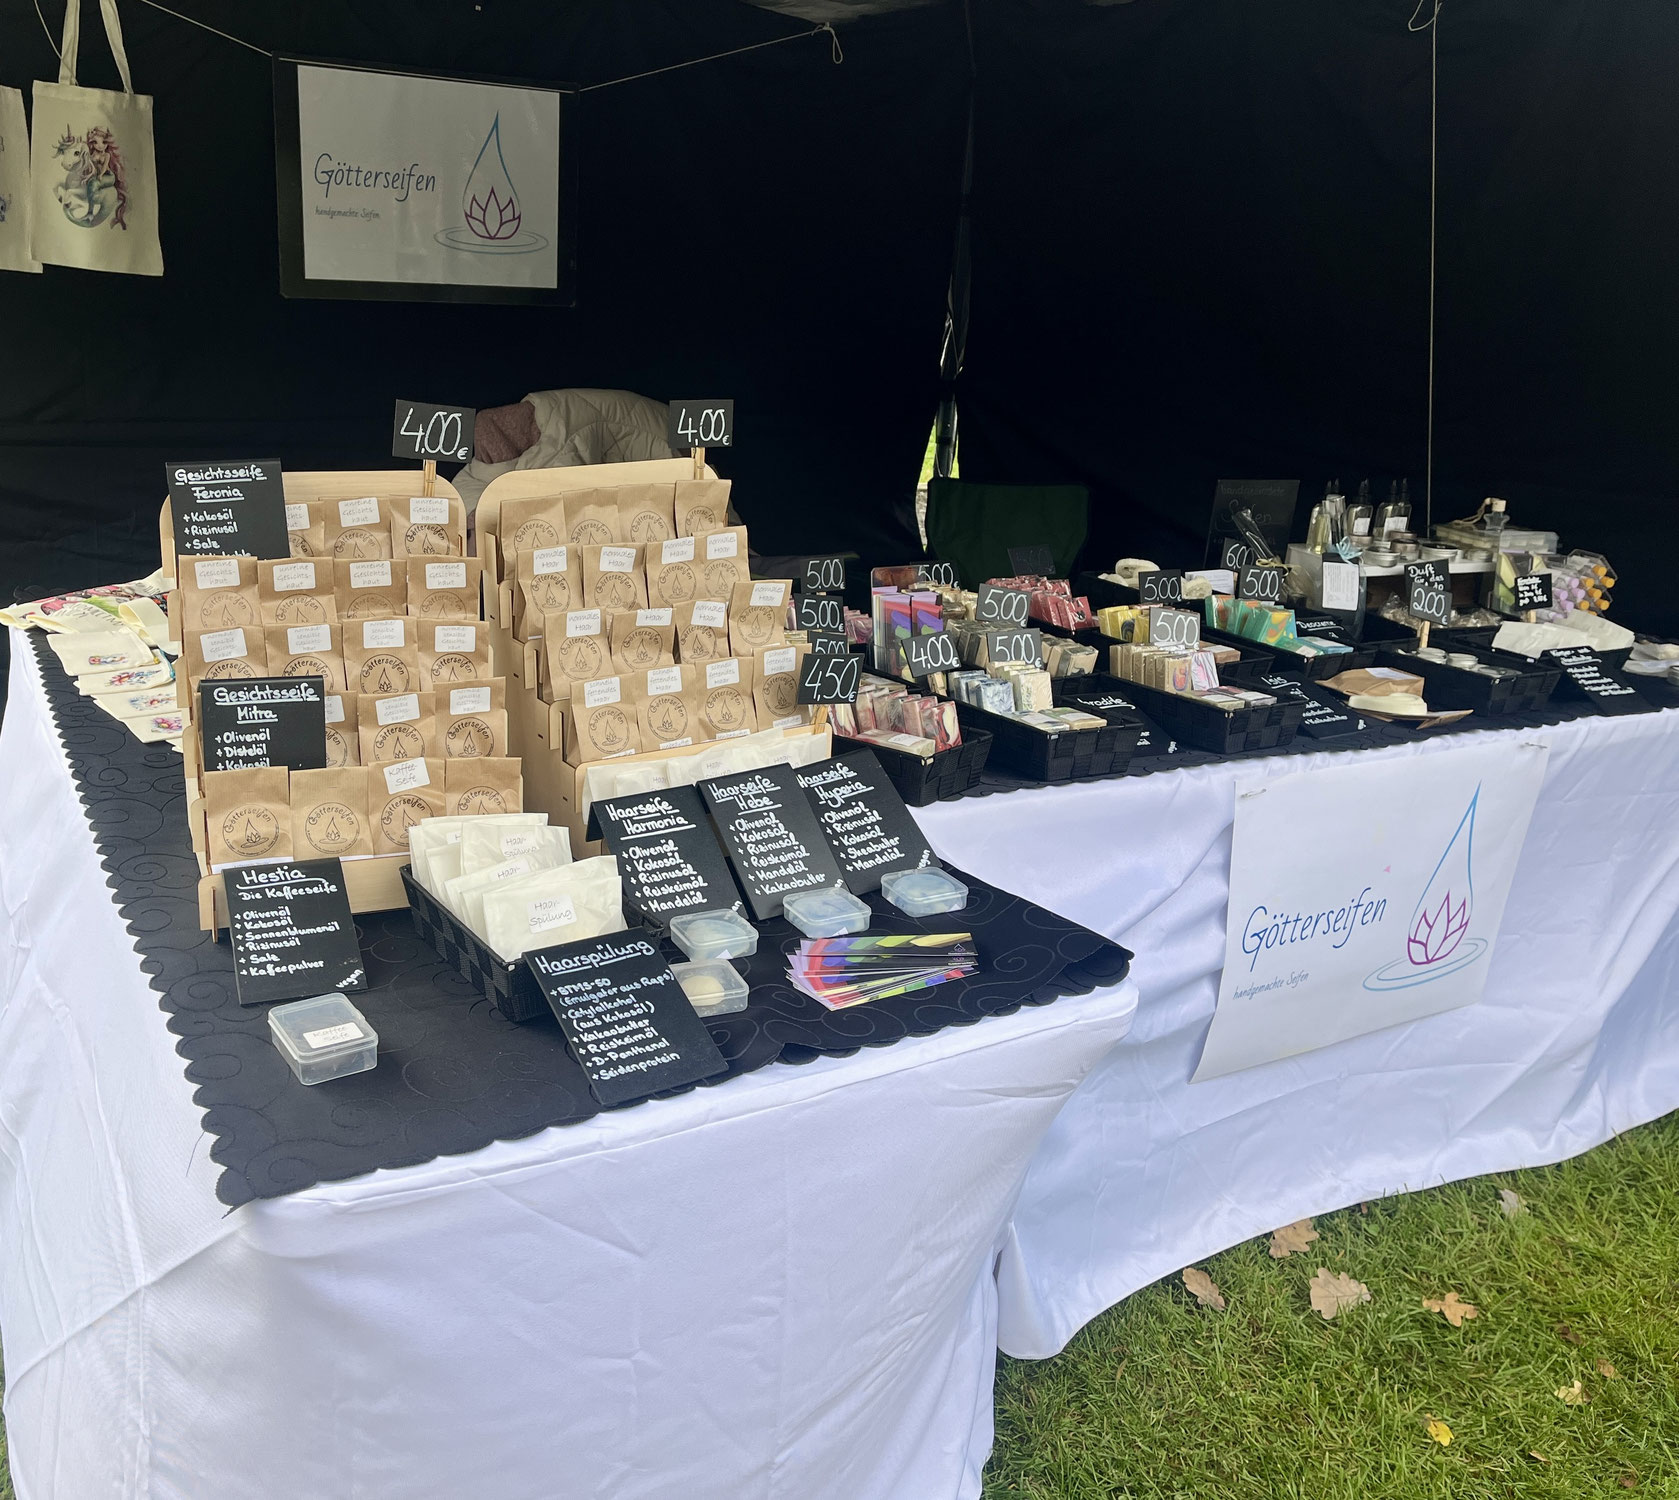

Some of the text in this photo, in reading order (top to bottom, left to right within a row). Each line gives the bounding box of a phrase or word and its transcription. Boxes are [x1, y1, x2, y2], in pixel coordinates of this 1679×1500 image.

[314, 153, 436, 203] Götterseifen
[316, 205, 381, 221] handgemachte Seifen
[174, 464, 265, 484] Gesichtsseife
[191, 486, 243, 501] Feronia
[190, 508, 234, 522] Kokosöl
[190, 522, 239, 536] Rizinusöl
[192, 537, 220, 549] Salz
[1408, 563, 1435, 578] Duft
[362, 657, 405, 678] Götterseifen
[433, 656, 472, 677] Götterseifen
[213, 682, 318, 703] Gesichtsseife
[236, 705, 279, 725] Mitra
[223, 728, 270, 744] Olivenöl
[376, 727, 419, 749] Götterseifen
[447, 721, 490, 740] Götterseifen
[223, 743, 266, 758] Distelöl
[796, 763, 856, 789] Haarseife
[708, 775, 776, 801] Haarseife
[818, 781, 867, 808] Hyperia
[459, 790, 502, 811] Götterseifen
[605, 797, 673, 821] Haarseife
[734, 795, 774, 812] Hebe
[225, 808, 271, 833] Götterseifen
[309, 806, 355, 825] Götterseifen
[383, 797, 426, 826] Götterseifen
[735, 811, 780, 832] Olivenöl
[823, 801, 870, 823] Olivenöl
[623, 815, 689, 835] Harmonia
[743, 822, 787, 845] Kokosöl
[832, 811, 883, 836] Rizinusöl
[506, 836, 527, 846] Haar-
[747, 832, 800, 856] Rizinusöl
[840, 824, 885, 848] Kokosöl
[629, 839, 679, 859] Olivenöl
[751, 845, 811, 869] Reiskeimöl
[847, 836, 901, 861] Sheabutter
[498, 866, 521, 879] Haar-
[634, 852, 684, 873] Kokosöl
[758, 863, 809, 883] Mandelöl
[854, 849, 906, 878] Mandelöl
[242, 865, 306, 886] Hestia
[638, 864, 698, 885] Rizinusöl
[762, 871, 826, 896] Kakaobutter
[239, 881, 338, 901] Die Kaffeeseife
[642, 876, 709, 898] Reiskeimöl
[242, 906, 290, 920] Olivenöl
[534, 899, 560, 911] Haar-
[648, 891, 708, 914] Mandelöl
[244, 917, 293, 931] Kokosöl
[530, 908, 573, 929] Spülung
[245, 921, 341, 941] Sonnenblumenöl
[1242, 887, 1387, 972] Götterseifen
[245, 937, 302, 953] Rizinusöl
[248, 958, 325, 977] Kaffeepulver
[249, 953, 281, 963] Salz
[535, 941, 656, 976] Haarspülung
[336, 969, 363, 989] vegan
[557, 977, 612, 996] BTMS-50
[560, 969, 675, 1008] (Emulgator aus Raps)
[1233, 970, 1310, 1000] handgemachte Seifen
[567, 994, 638, 1019] Cetylalkohol
[573, 1001, 656, 1032] (aus Kokosöl)
[579, 1019, 651, 1043] Kakaobutter
[589, 1027, 660, 1054] Reiskeimöl
[590, 1037, 671, 1066] D-Panthenol
[600, 1050, 682, 1081] Seidenprotein
